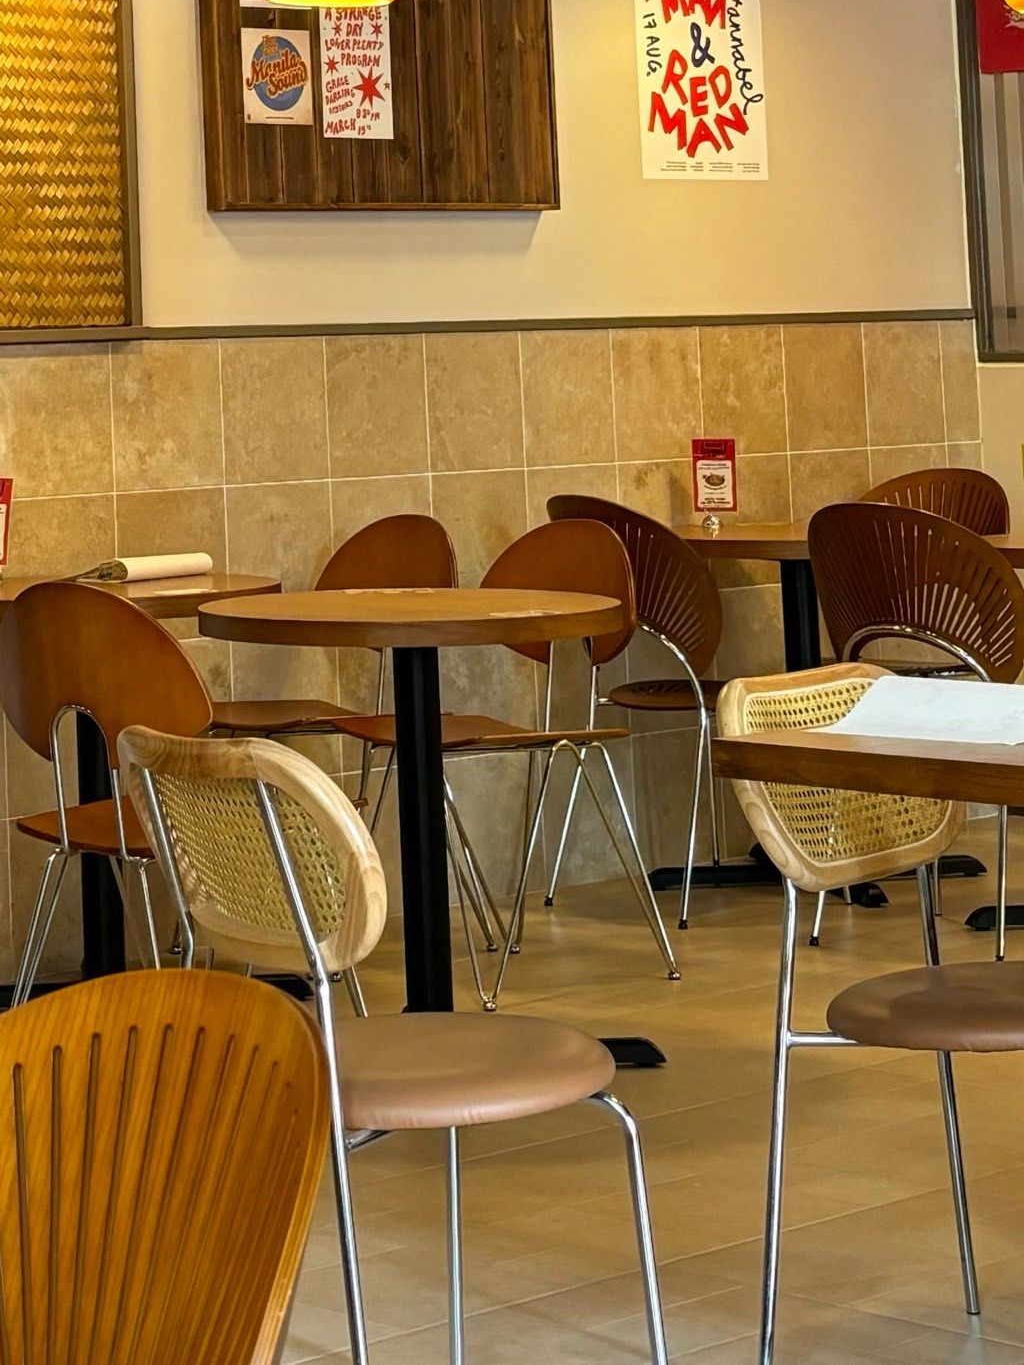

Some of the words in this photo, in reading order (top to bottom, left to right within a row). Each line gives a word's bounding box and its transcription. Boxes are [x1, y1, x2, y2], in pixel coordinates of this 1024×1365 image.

[346, 22, 364, 37] DAY
[643, 13, 657, 29] 17
[325, 38, 351, 52] LOWER
[352, 38, 384, 52] PLENTY
[690, 22, 716, 68] &
[246, 48, 301, 90] Manila
[340, 53, 381, 68] PROGRAM
[267, 61, 309, 97] Sound
[325, 75, 350, 93] GRACE
[661, 49, 732, 117] RED
[325, 88, 356, 106] DARLING
[325, 118, 356, 135] MARCH
[647, 91, 750, 158] MAN
